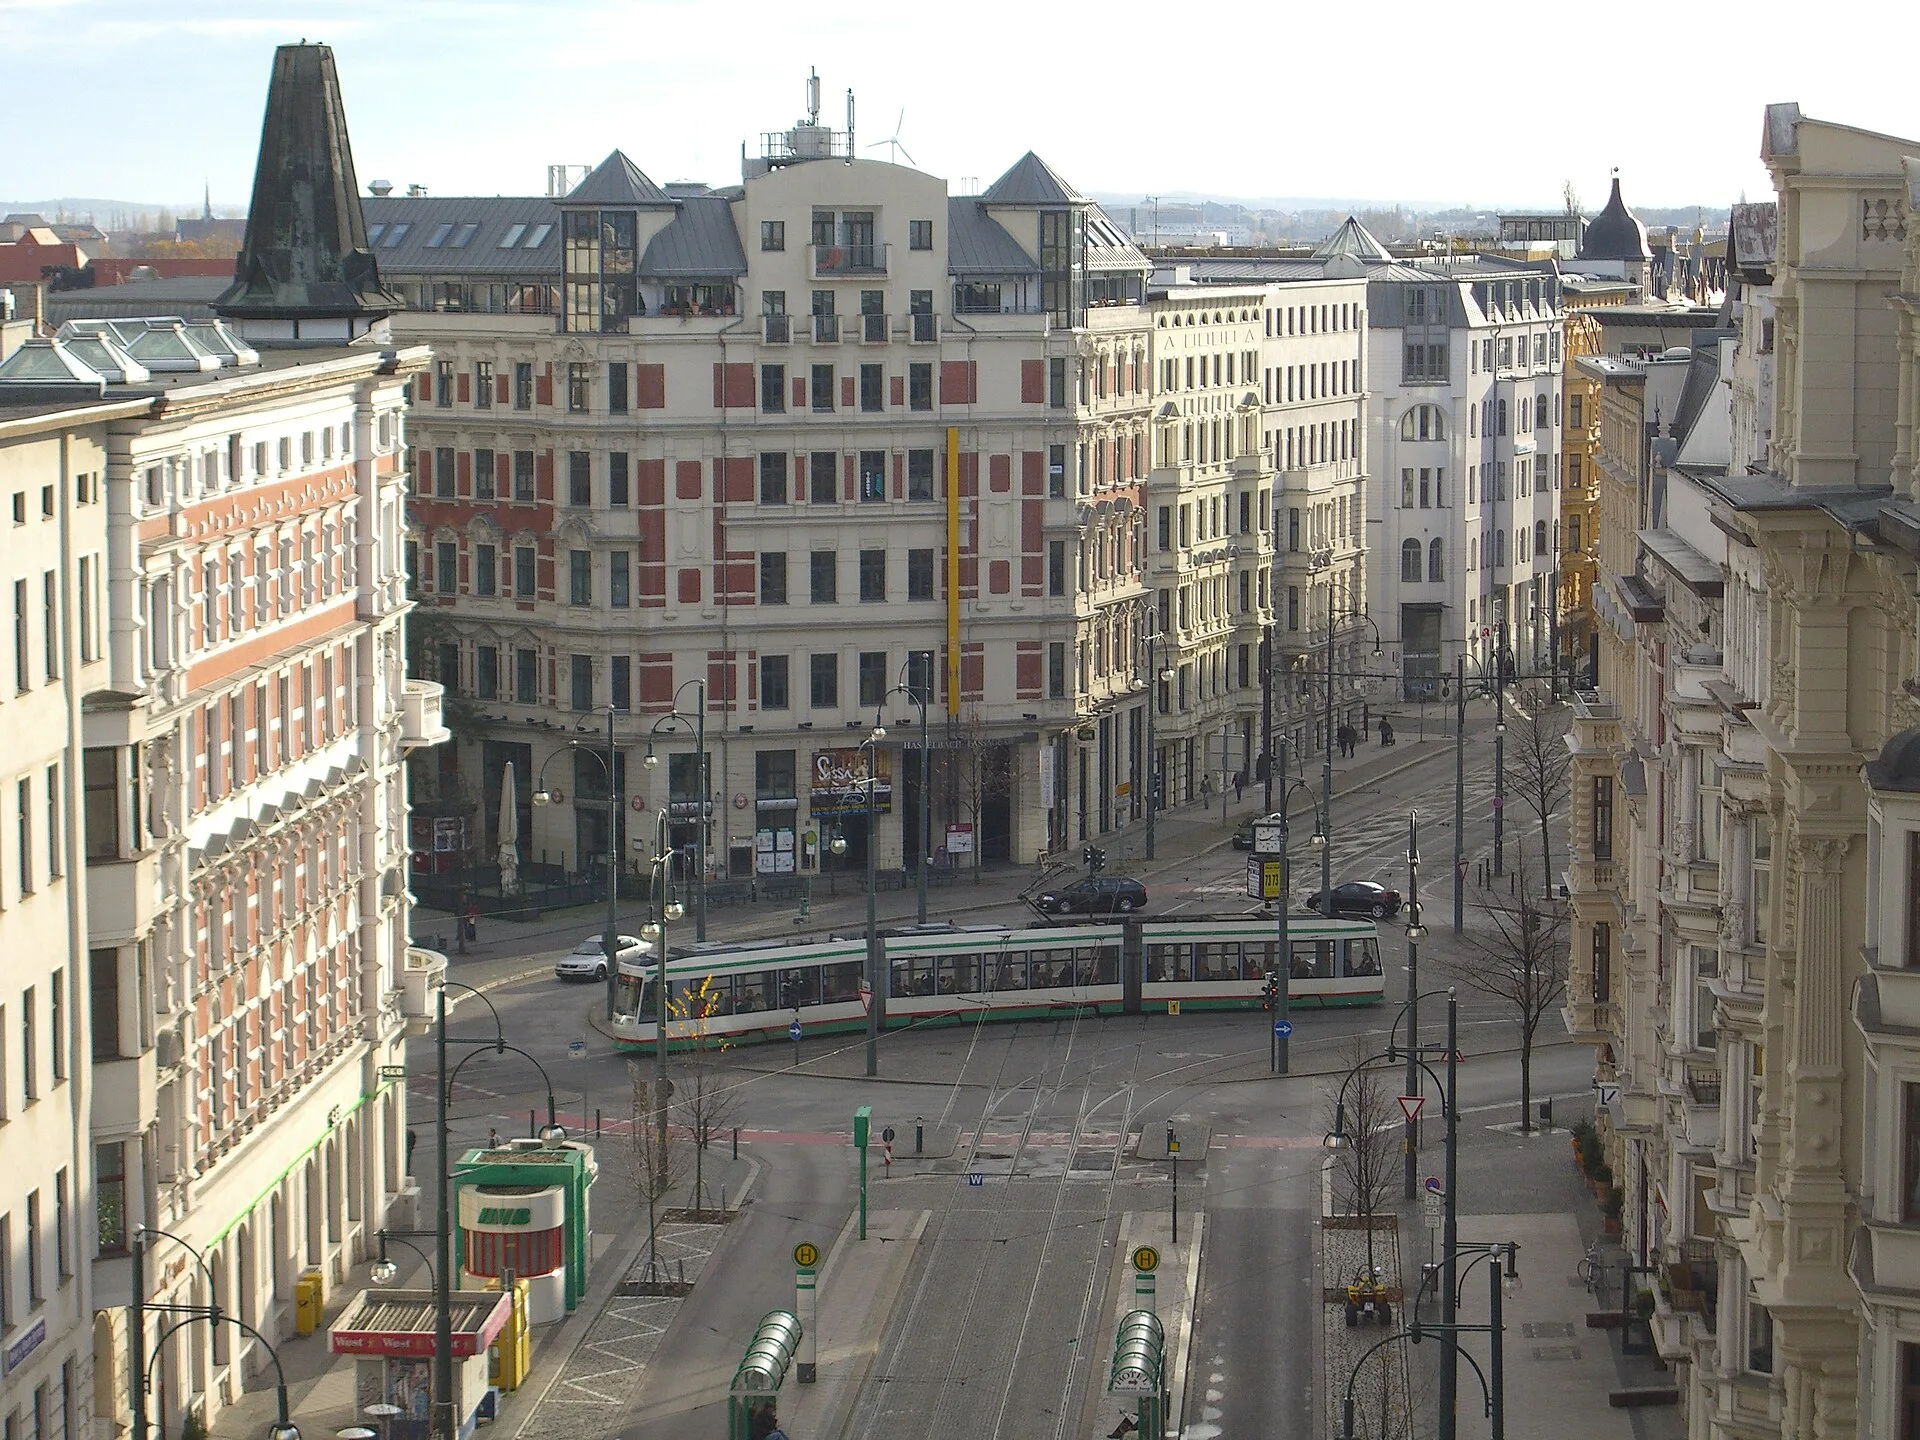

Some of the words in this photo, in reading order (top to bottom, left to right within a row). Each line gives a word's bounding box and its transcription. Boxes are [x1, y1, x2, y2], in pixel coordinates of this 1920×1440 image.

[903, 741, 961, 749] HASELBACH
[1265, 874, 1271, 887] 73
[1272, 874, 1279, 886] 73
[383, 1067, 404, 1076] SEB
[970, 1174, 982, 1185] W
[801, 1247, 811, 1262] H
[1140, 1253, 1151, 1266] H
[335, 1336, 364, 1347] West
[383, 1337, 411, 1348] West
[1115, 1370, 1149, 1385] HOTEL
